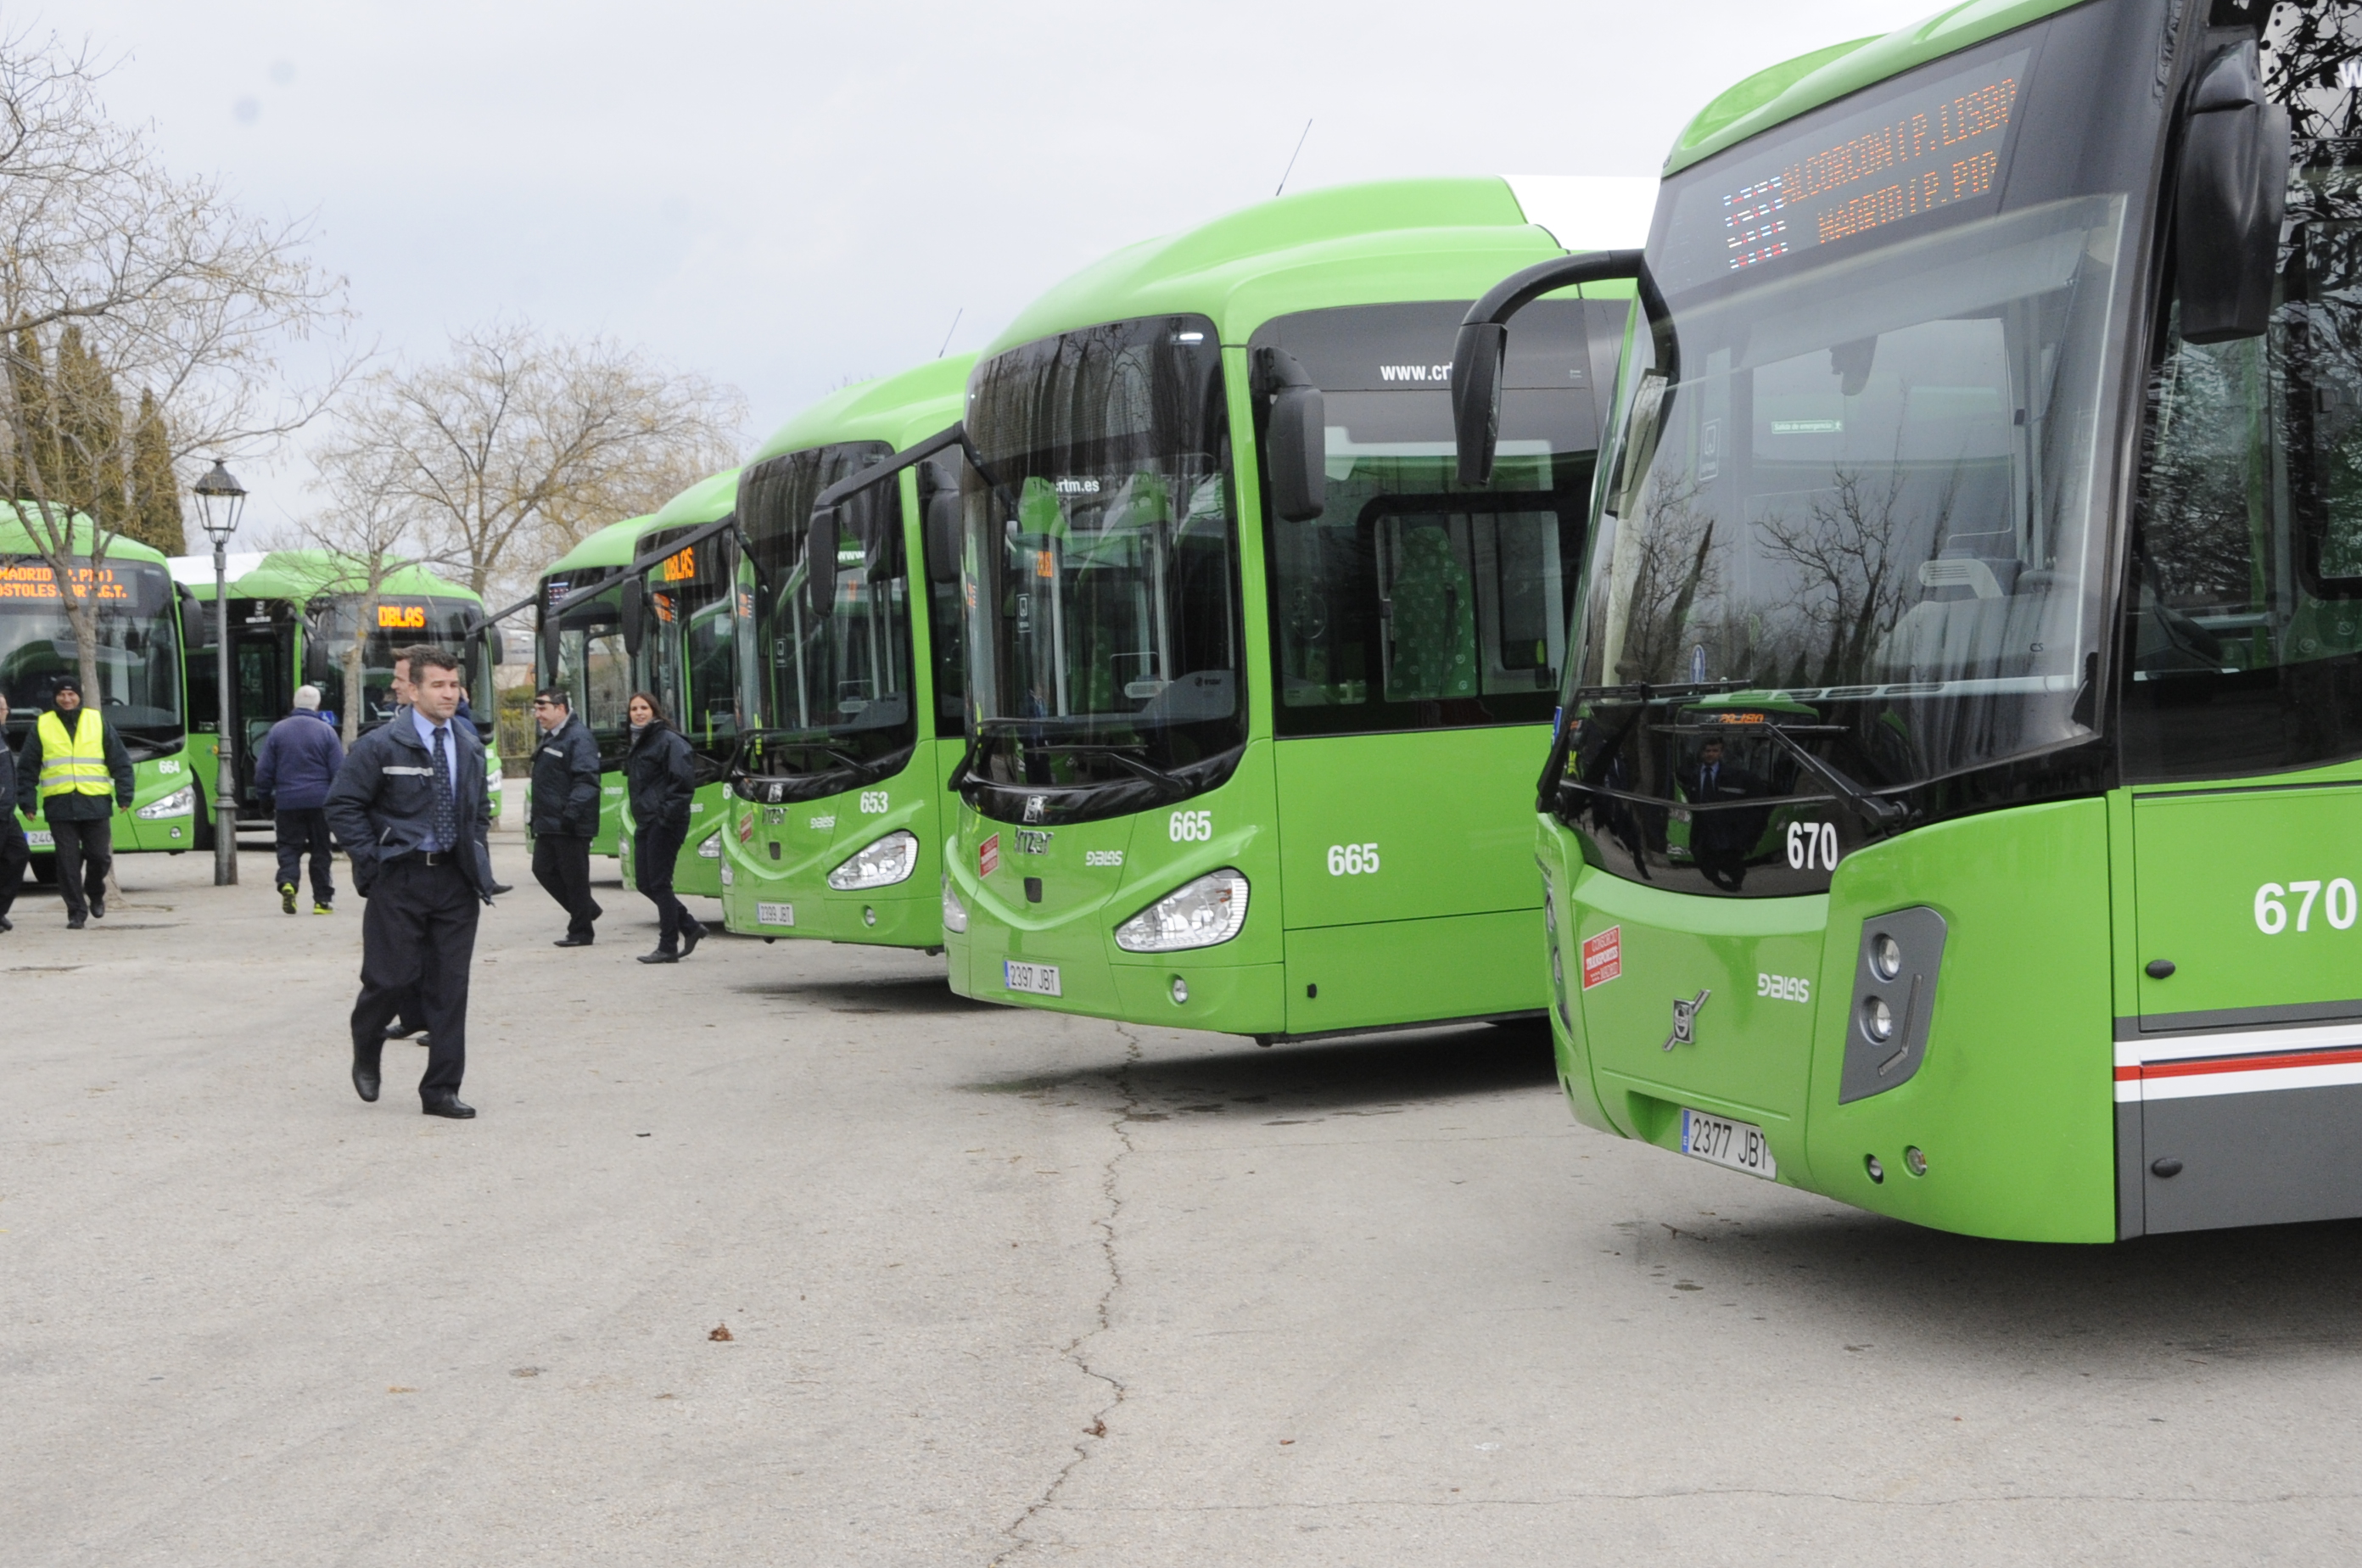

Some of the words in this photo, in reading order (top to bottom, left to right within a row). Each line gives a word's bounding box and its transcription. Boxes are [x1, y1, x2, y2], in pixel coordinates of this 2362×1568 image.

[378, 606, 425, 627] DBLAS
[159, 760, 181, 774] 664
[859, 791, 889, 814] 653
[31, 832, 53, 843] 240
[1168, 810, 1212, 843] 665
[1327, 843, 1380, 876] 665
[1787, 820, 1839, 871] 670
[2254, 877, 2358, 935] 670
[1010, 965, 1033, 988] 2397
[1038, 968, 1055, 991] JBT
[1693, 1117, 1732, 1159] 2377
